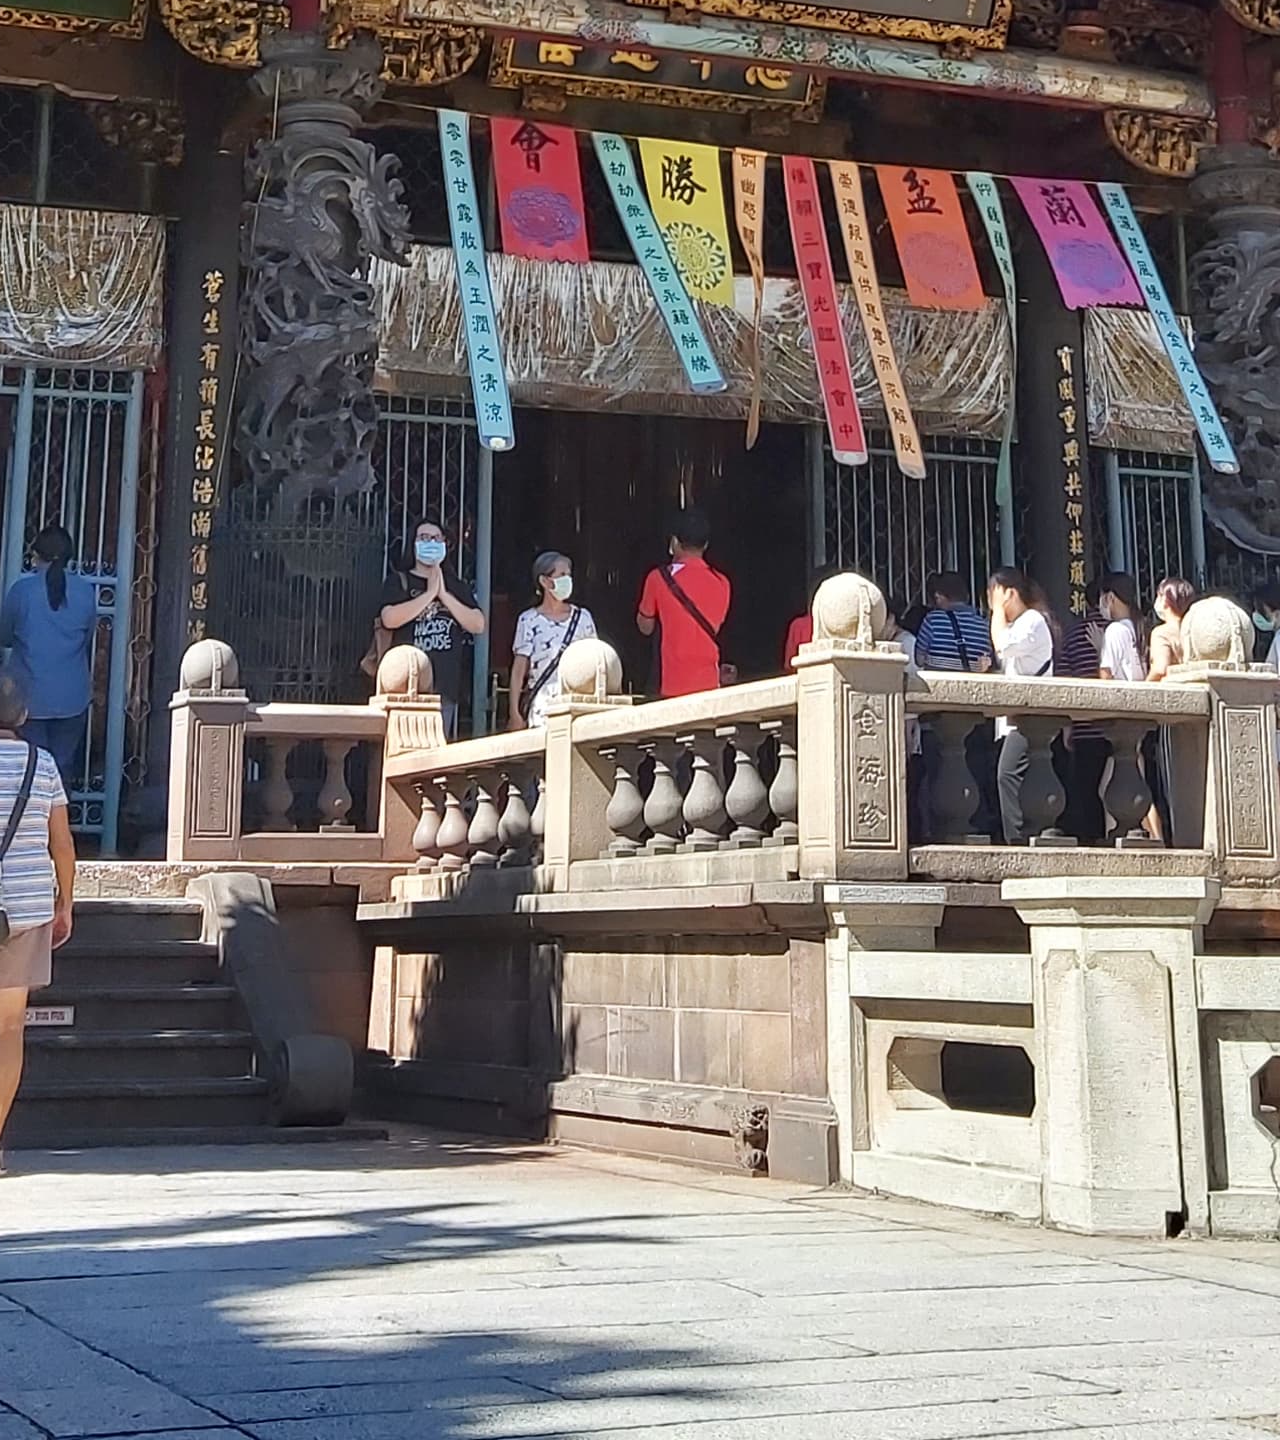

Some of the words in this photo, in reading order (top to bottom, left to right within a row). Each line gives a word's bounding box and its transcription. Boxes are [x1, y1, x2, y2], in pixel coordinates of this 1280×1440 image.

[510, 119, 560, 174] 會
[661, 154, 707, 206] 勝
[901, 167, 943, 215] 盆
[1039, 184, 1087, 229] 蘭
[414, 619, 454, 637] MICKEY
[414, 634, 452, 651] MOUSE
